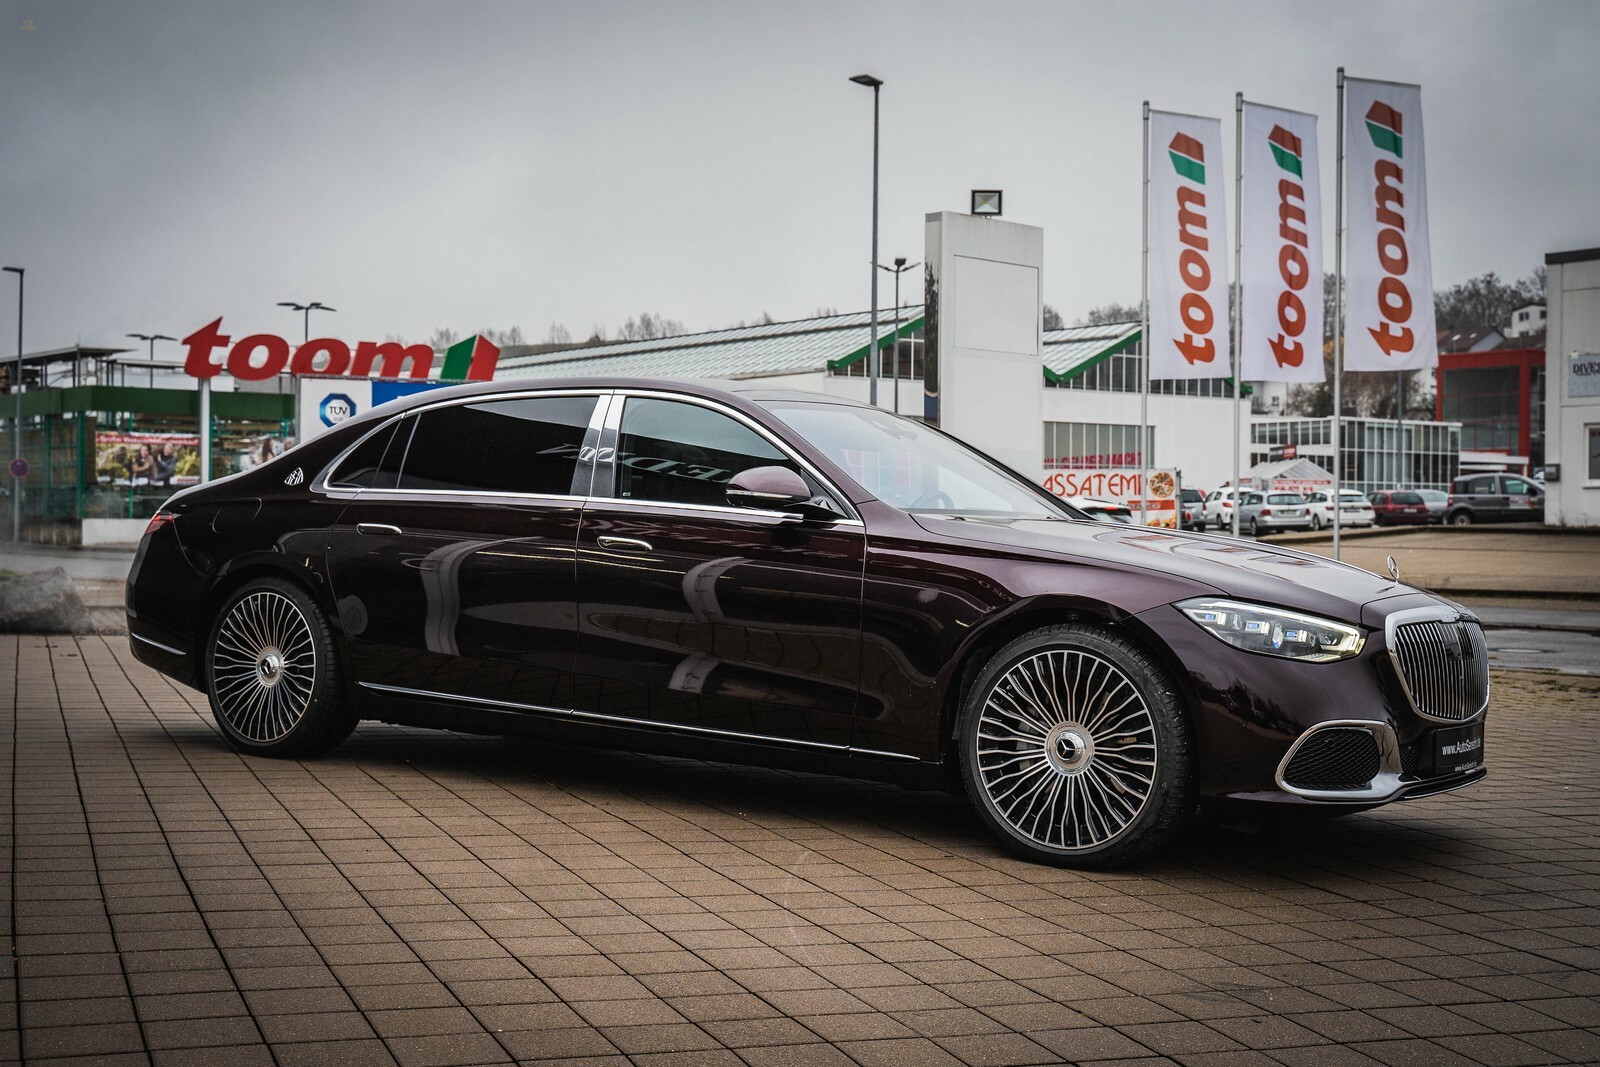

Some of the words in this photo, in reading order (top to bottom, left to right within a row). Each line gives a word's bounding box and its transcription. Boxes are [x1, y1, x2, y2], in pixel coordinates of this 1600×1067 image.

[181, 316, 435, 381] toom
[1172, 186, 1216, 366] toom
[1268, 178, 1309, 369] toom
[1367, 159, 1414, 357] toom
